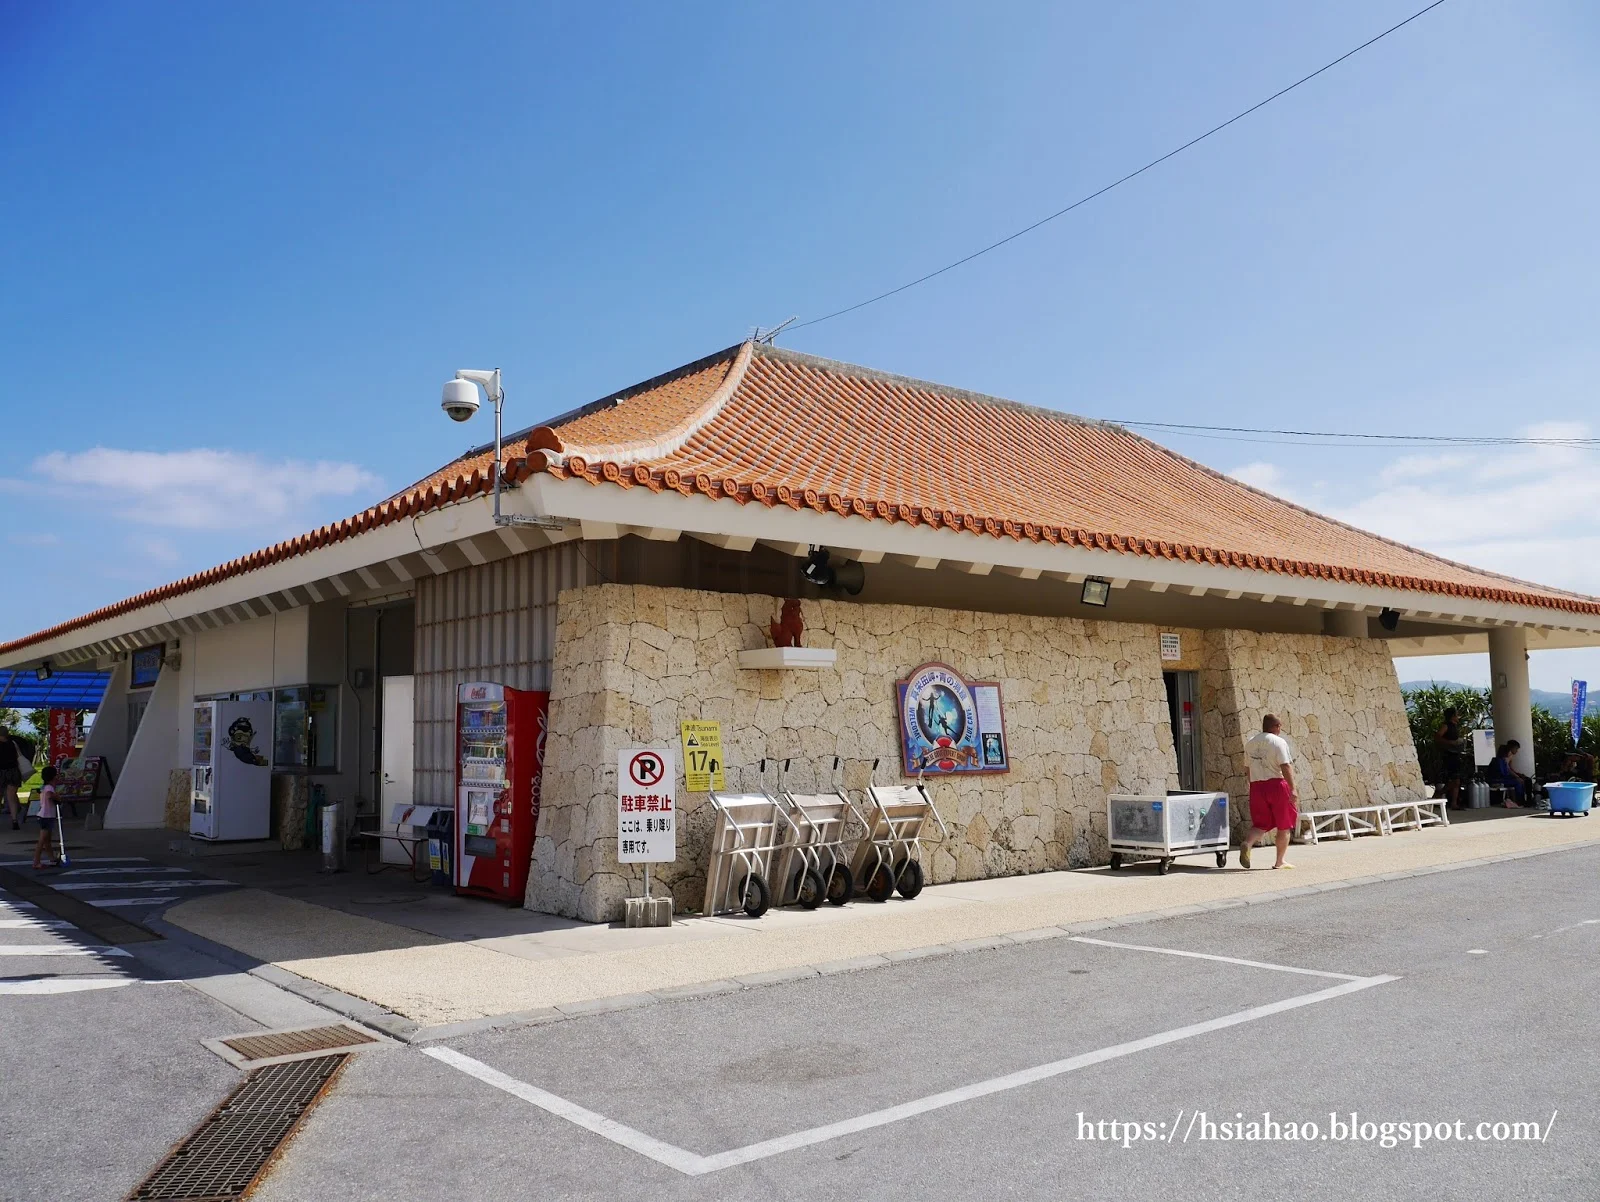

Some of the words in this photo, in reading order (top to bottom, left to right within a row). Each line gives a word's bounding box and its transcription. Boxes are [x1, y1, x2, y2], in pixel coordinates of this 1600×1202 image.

[909, 706, 921, 740] WELCOME
[964, 725, 973, 742] BLUE
[621, 794, 672, 812] 駐車禁止
[621, 819, 671, 832] ここは、乗り降り
[622, 839, 650, 854] 専用です。
